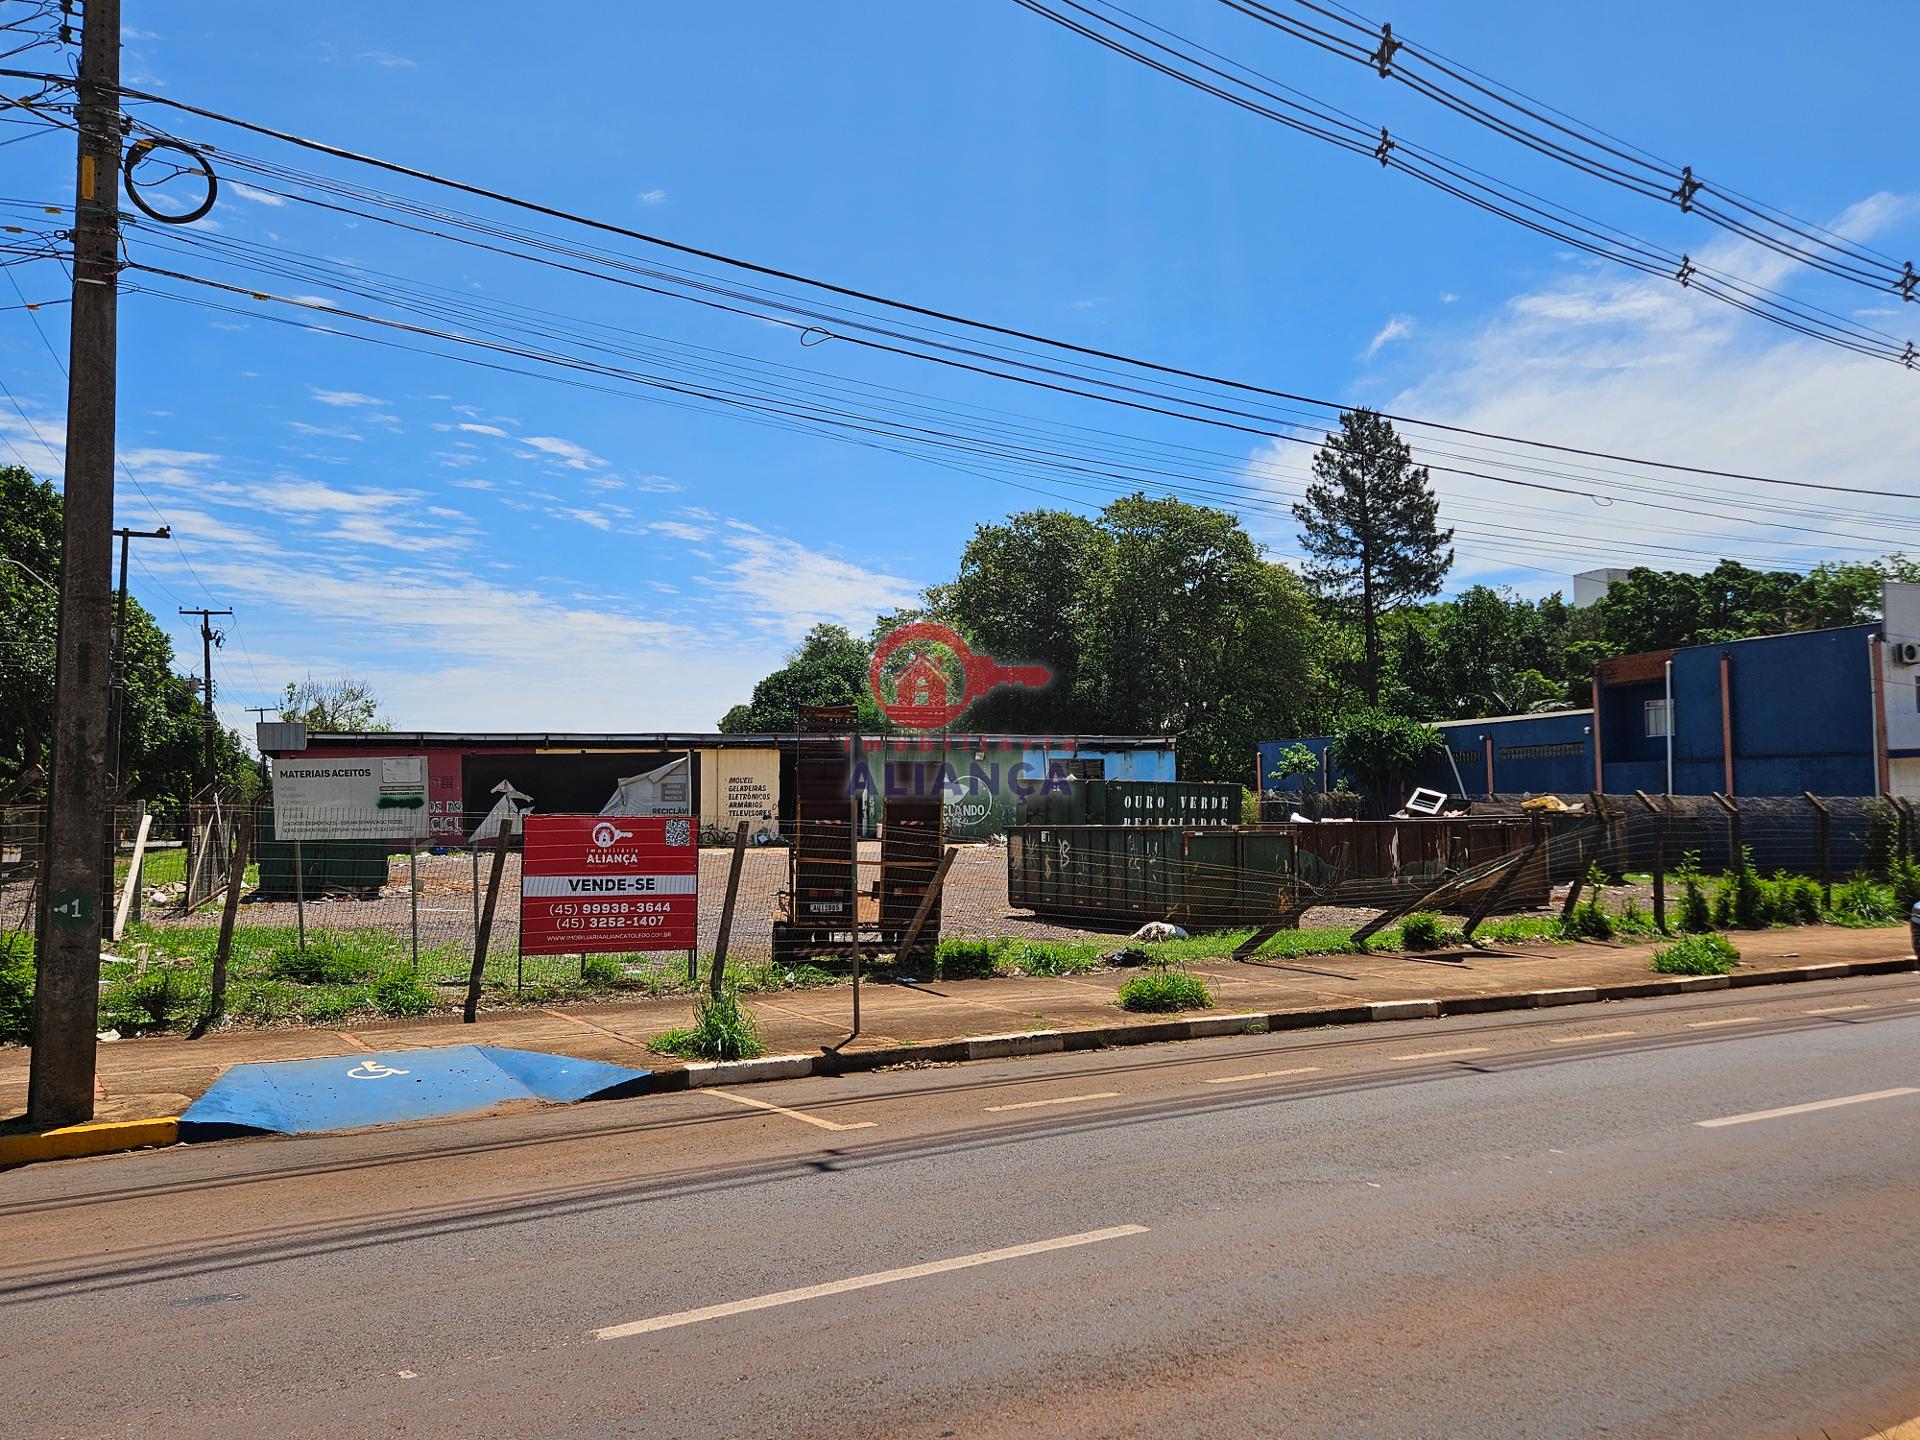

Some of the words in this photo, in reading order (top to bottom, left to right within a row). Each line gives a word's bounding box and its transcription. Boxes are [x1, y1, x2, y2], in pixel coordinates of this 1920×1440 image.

[280, 769, 330, 779] MATERIAIS
[332, 768, 371, 778] ACEITOS
[728, 801, 763, 809] ARMÁRIOS
[1124, 796, 1165, 809] OURO
[1180, 796, 1229, 809] VERDE
[728, 809, 772, 817] TELEVISORES
[586, 854, 638, 865] ALIANÇA
[568, 878, 656, 892] VENDE-SE
[71, 898, 82, 918] 1
[549, 904, 578, 916] (45)
[582, 902, 671, 914] 99938-3644
[556, 917, 585, 929] (45)
[589, 916, 665, 928] 3252-1407
